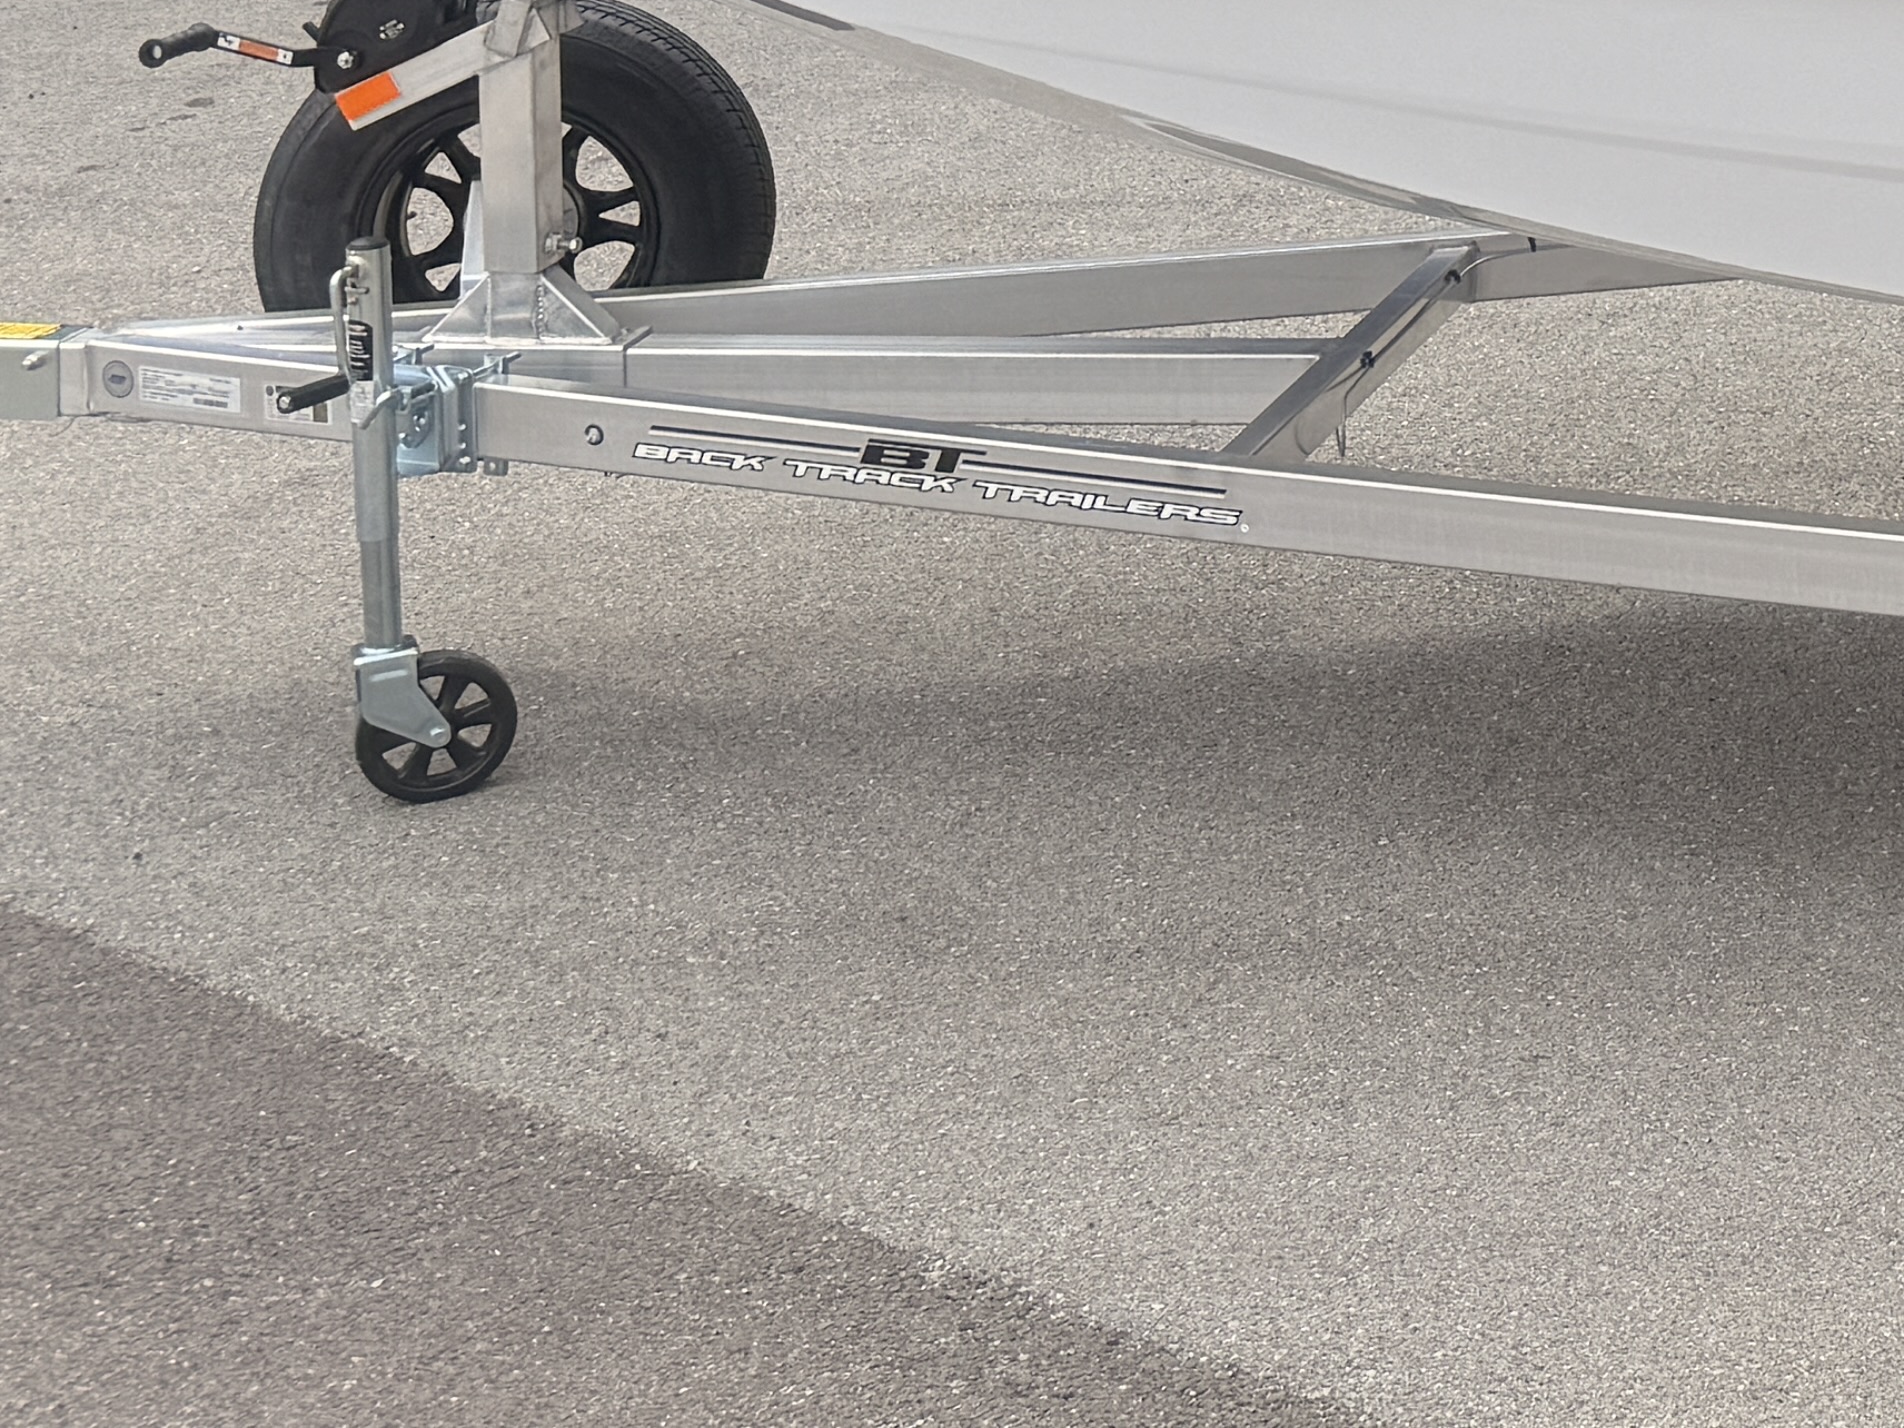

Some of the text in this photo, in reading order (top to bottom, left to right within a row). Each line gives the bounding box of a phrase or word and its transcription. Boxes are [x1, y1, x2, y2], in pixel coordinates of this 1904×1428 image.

[631, 441, 1244, 527] BACK TRACK TRAILERS
[857, 438, 986, 475] BT
